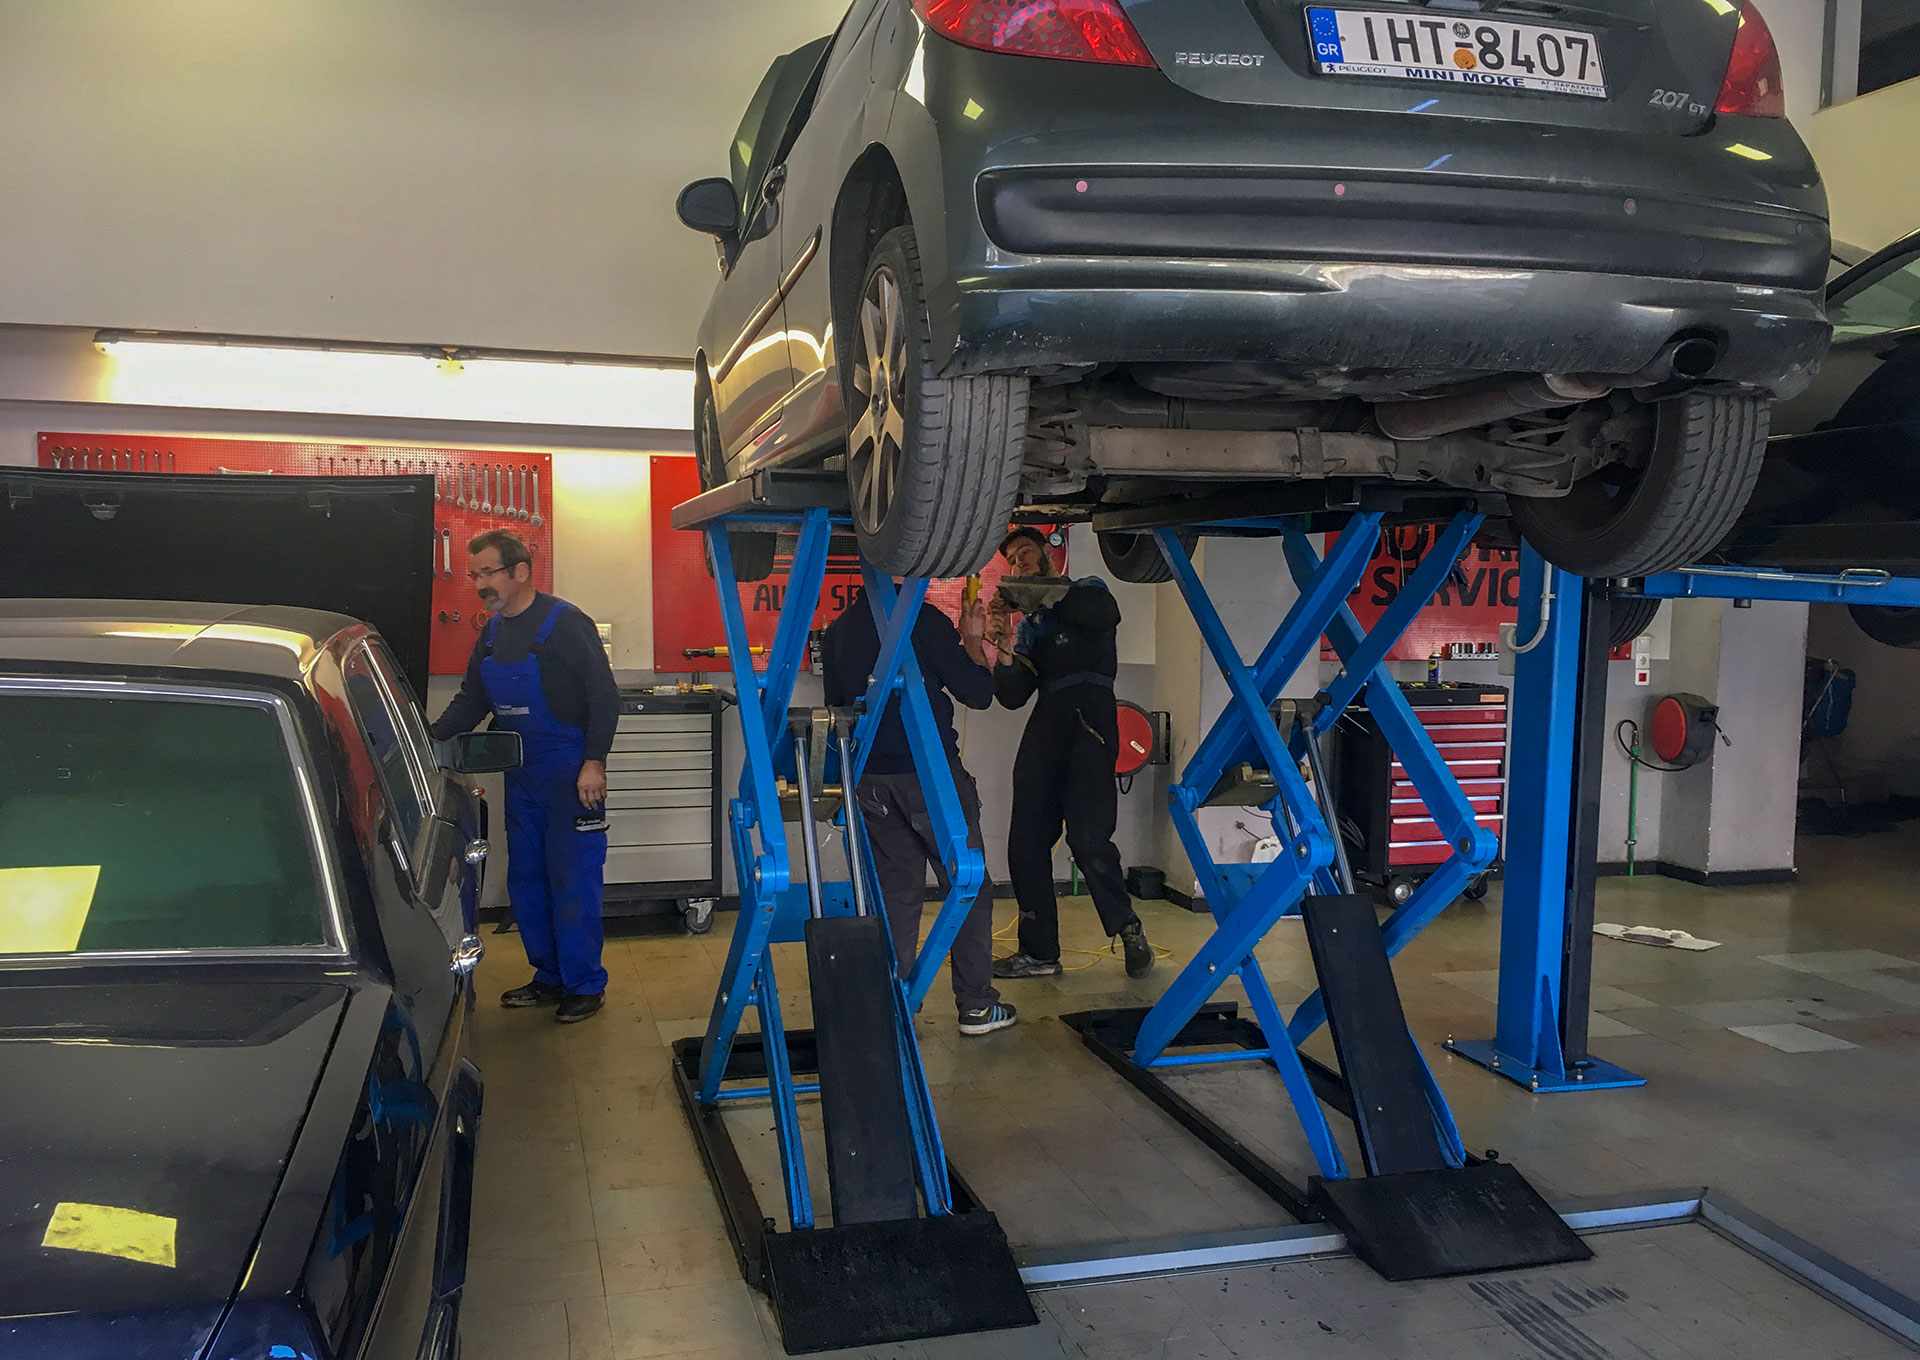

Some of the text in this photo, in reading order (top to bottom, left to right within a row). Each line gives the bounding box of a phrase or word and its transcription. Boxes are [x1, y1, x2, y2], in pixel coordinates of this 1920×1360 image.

[1317, 43, 1339, 56] GR
[1175, 51, 1265, 67] PEUGEOT
[1338, 65, 1387, 74] PEUGEOT
[1405, 68, 1526, 88] MINI MOKE
[1648, 88, 1707, 114] 207 GT
